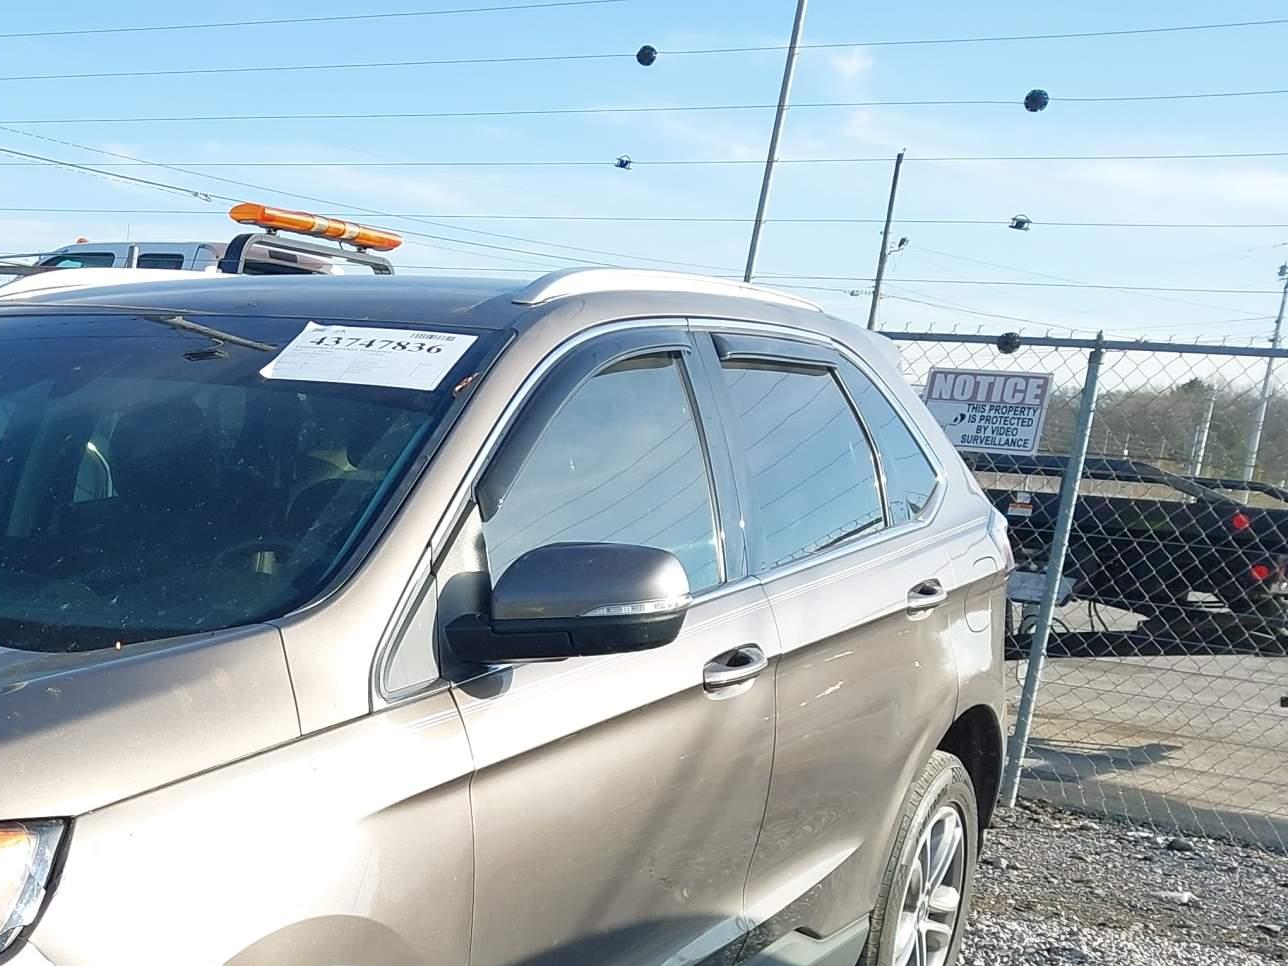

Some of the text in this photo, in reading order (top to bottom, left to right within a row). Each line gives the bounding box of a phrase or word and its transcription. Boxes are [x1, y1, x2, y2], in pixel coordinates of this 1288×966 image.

[309, 334, 443, 354] 43747836
[931, 373, 1044, 405] NOTICE
[966, 403, 1039, 417] THIS PROPERTY
[967, 414, 1034, 427] IS PROTECTED
[975, 425, 1019, 437] BY VIDEO
[960, 433, 1030, 449] SURVEILLANCE
